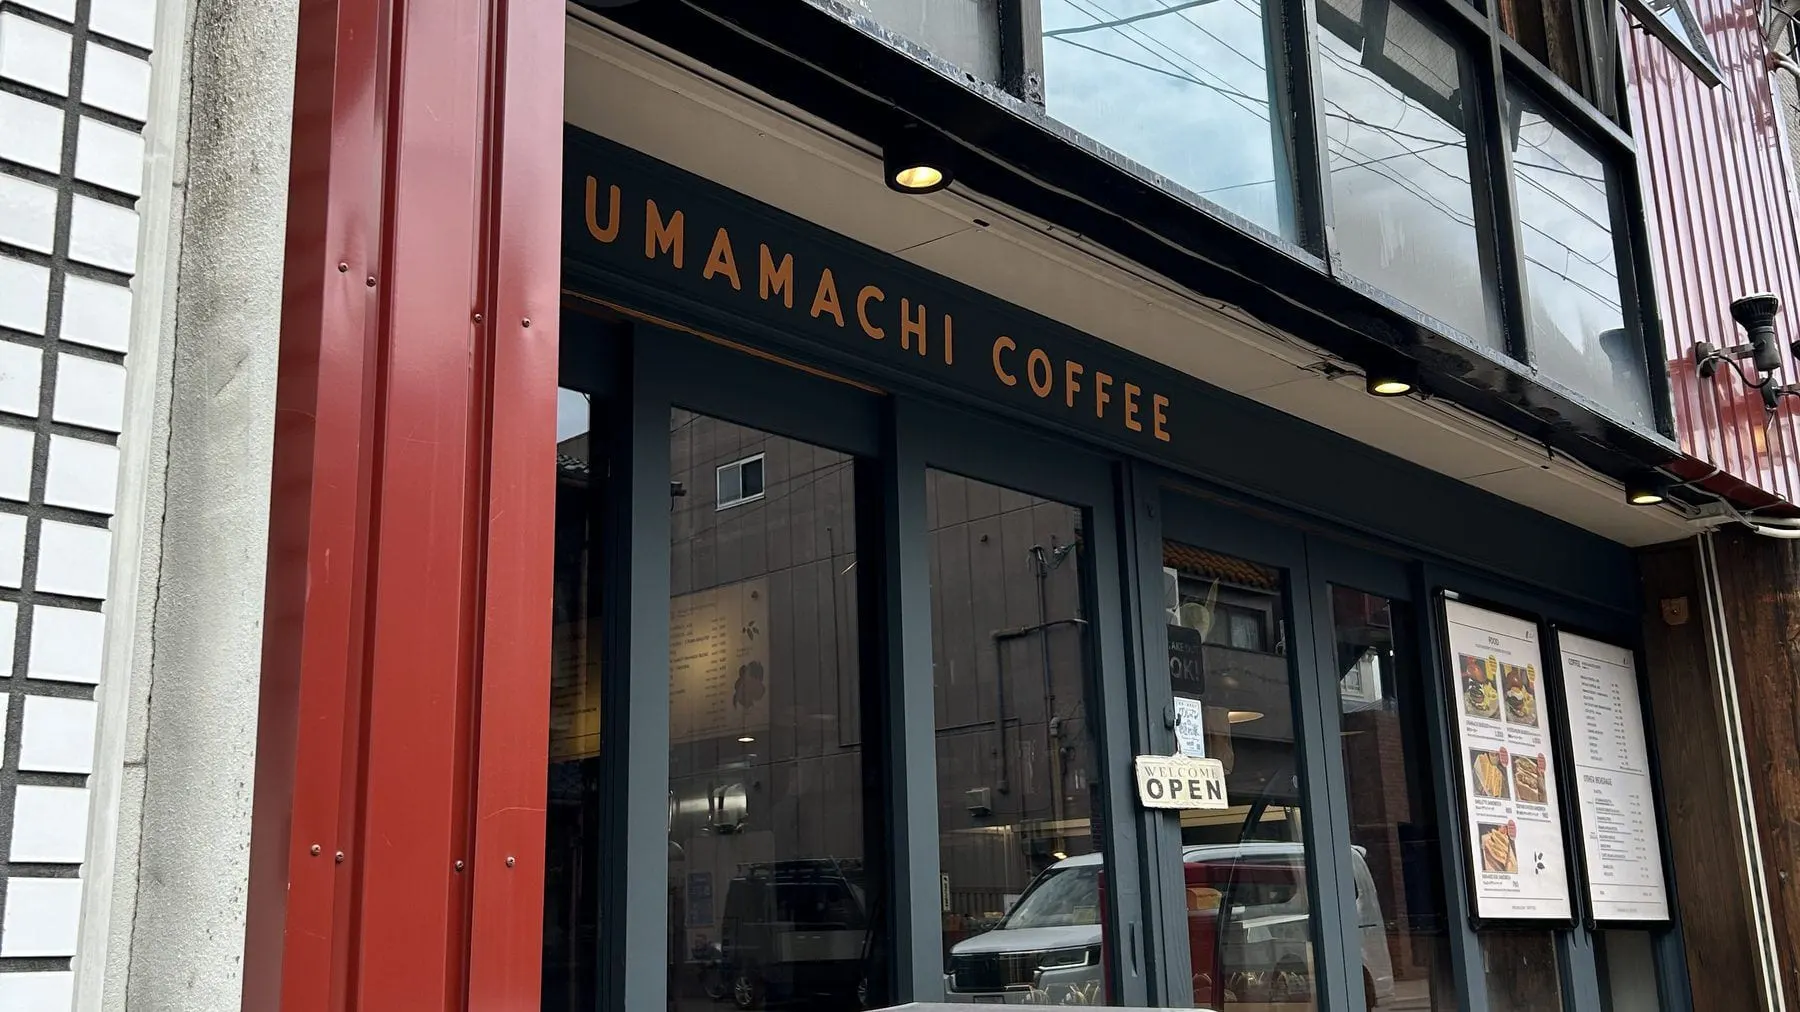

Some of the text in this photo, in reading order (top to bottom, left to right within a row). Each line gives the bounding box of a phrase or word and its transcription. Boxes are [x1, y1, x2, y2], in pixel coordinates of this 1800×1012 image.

[585, 175, 1171, 442] UMAMACHI COFFEE
[1170, 656, 1200, 681] OK!
[1144, 766, 1219, 779] WELCOME
[1146, 779, 1222, 800] OPEN
